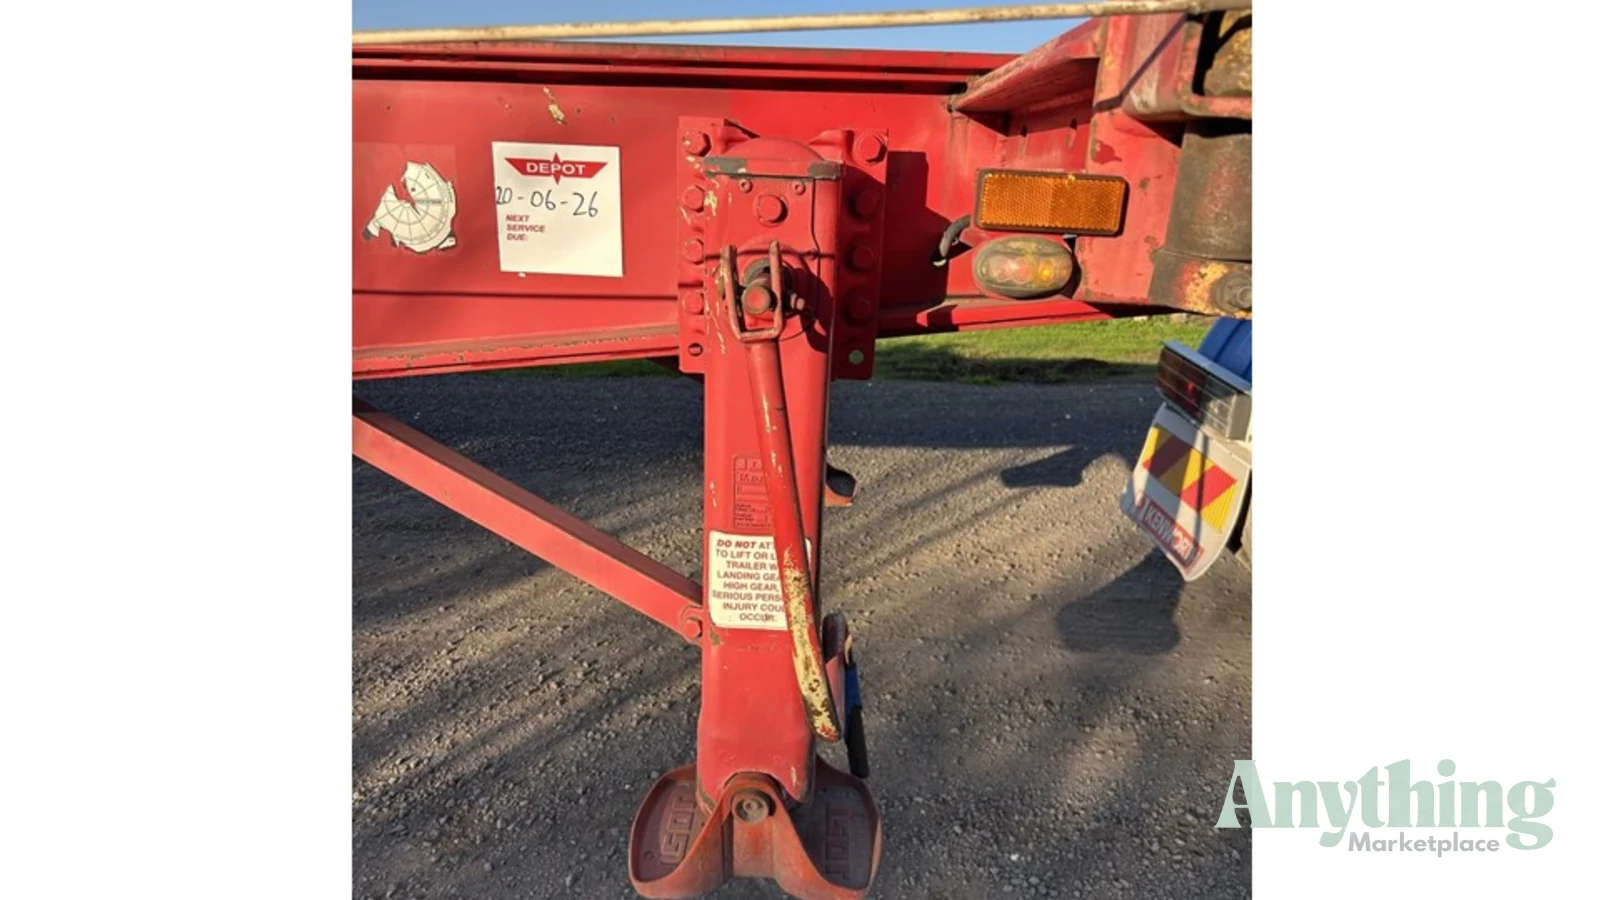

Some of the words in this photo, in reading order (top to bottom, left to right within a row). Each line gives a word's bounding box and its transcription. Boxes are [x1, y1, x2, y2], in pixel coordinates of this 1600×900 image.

[525, 162, 586, 175] DEPOT
[506, 214, 530, 222] NEXT
[507, 224, 545, 233] SERVICE
[507, 233, 528, 241] DUE:
[717, 539, 732, 548] DO
[735, 541, 757, 549] NOT
[716, 549, 728, 558] TO
[731, 551, 751, 559] LIFT
[753, 552, 768, 560] OR
[726, 561, 767, 569] TRAILER
[717, 571, 760, 580] LANDING
[723, 582, 748, 590] HIGH
[750, 583, 779, 592] GEAR,
[713, 590, 753, 600] SERIOUS
[755, 593, 783, 602] PERS
[723, 602, 757, 611] INJURY
